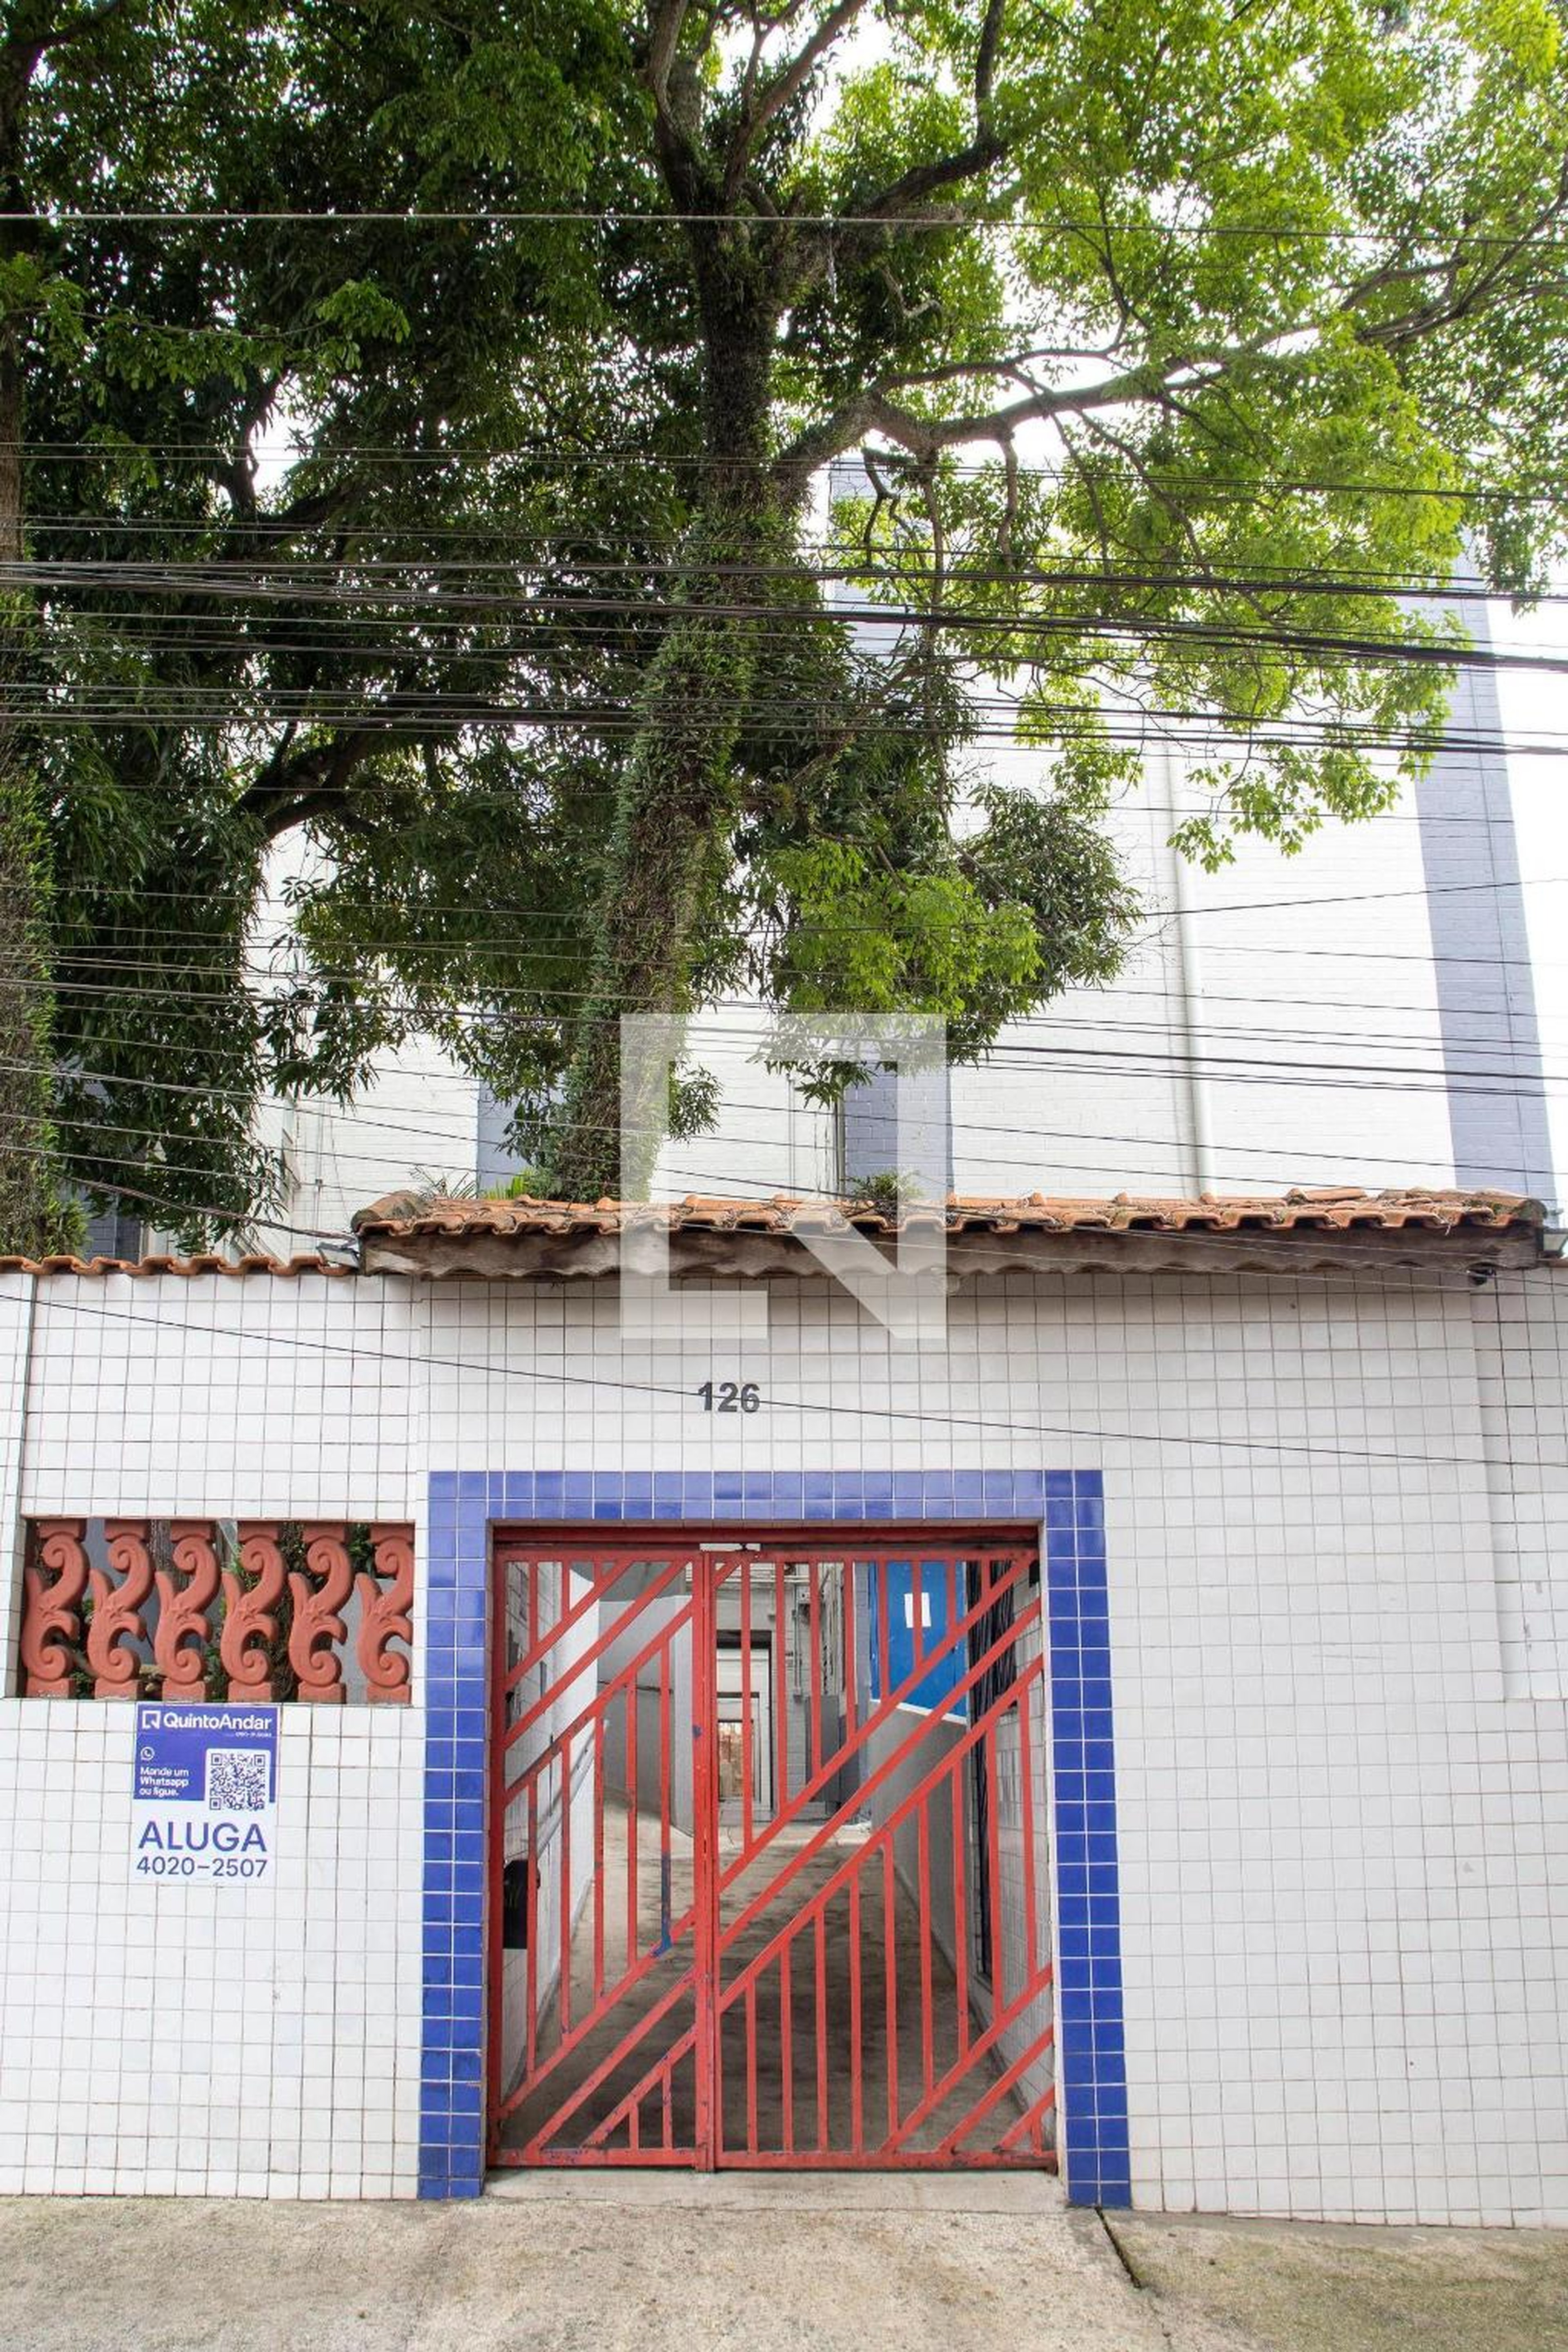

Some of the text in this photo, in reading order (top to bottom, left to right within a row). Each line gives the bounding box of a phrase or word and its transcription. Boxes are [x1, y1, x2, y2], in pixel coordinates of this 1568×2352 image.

[698, 1382, 760, 1413] 126
[163, 1712, 272, 1730] QuintoAndar
[140, 1766, 172, 1776] Mande
[138, 1821, 267, 1852] ALUGA
[136, 1856, 268, 1877] 4020-2507
